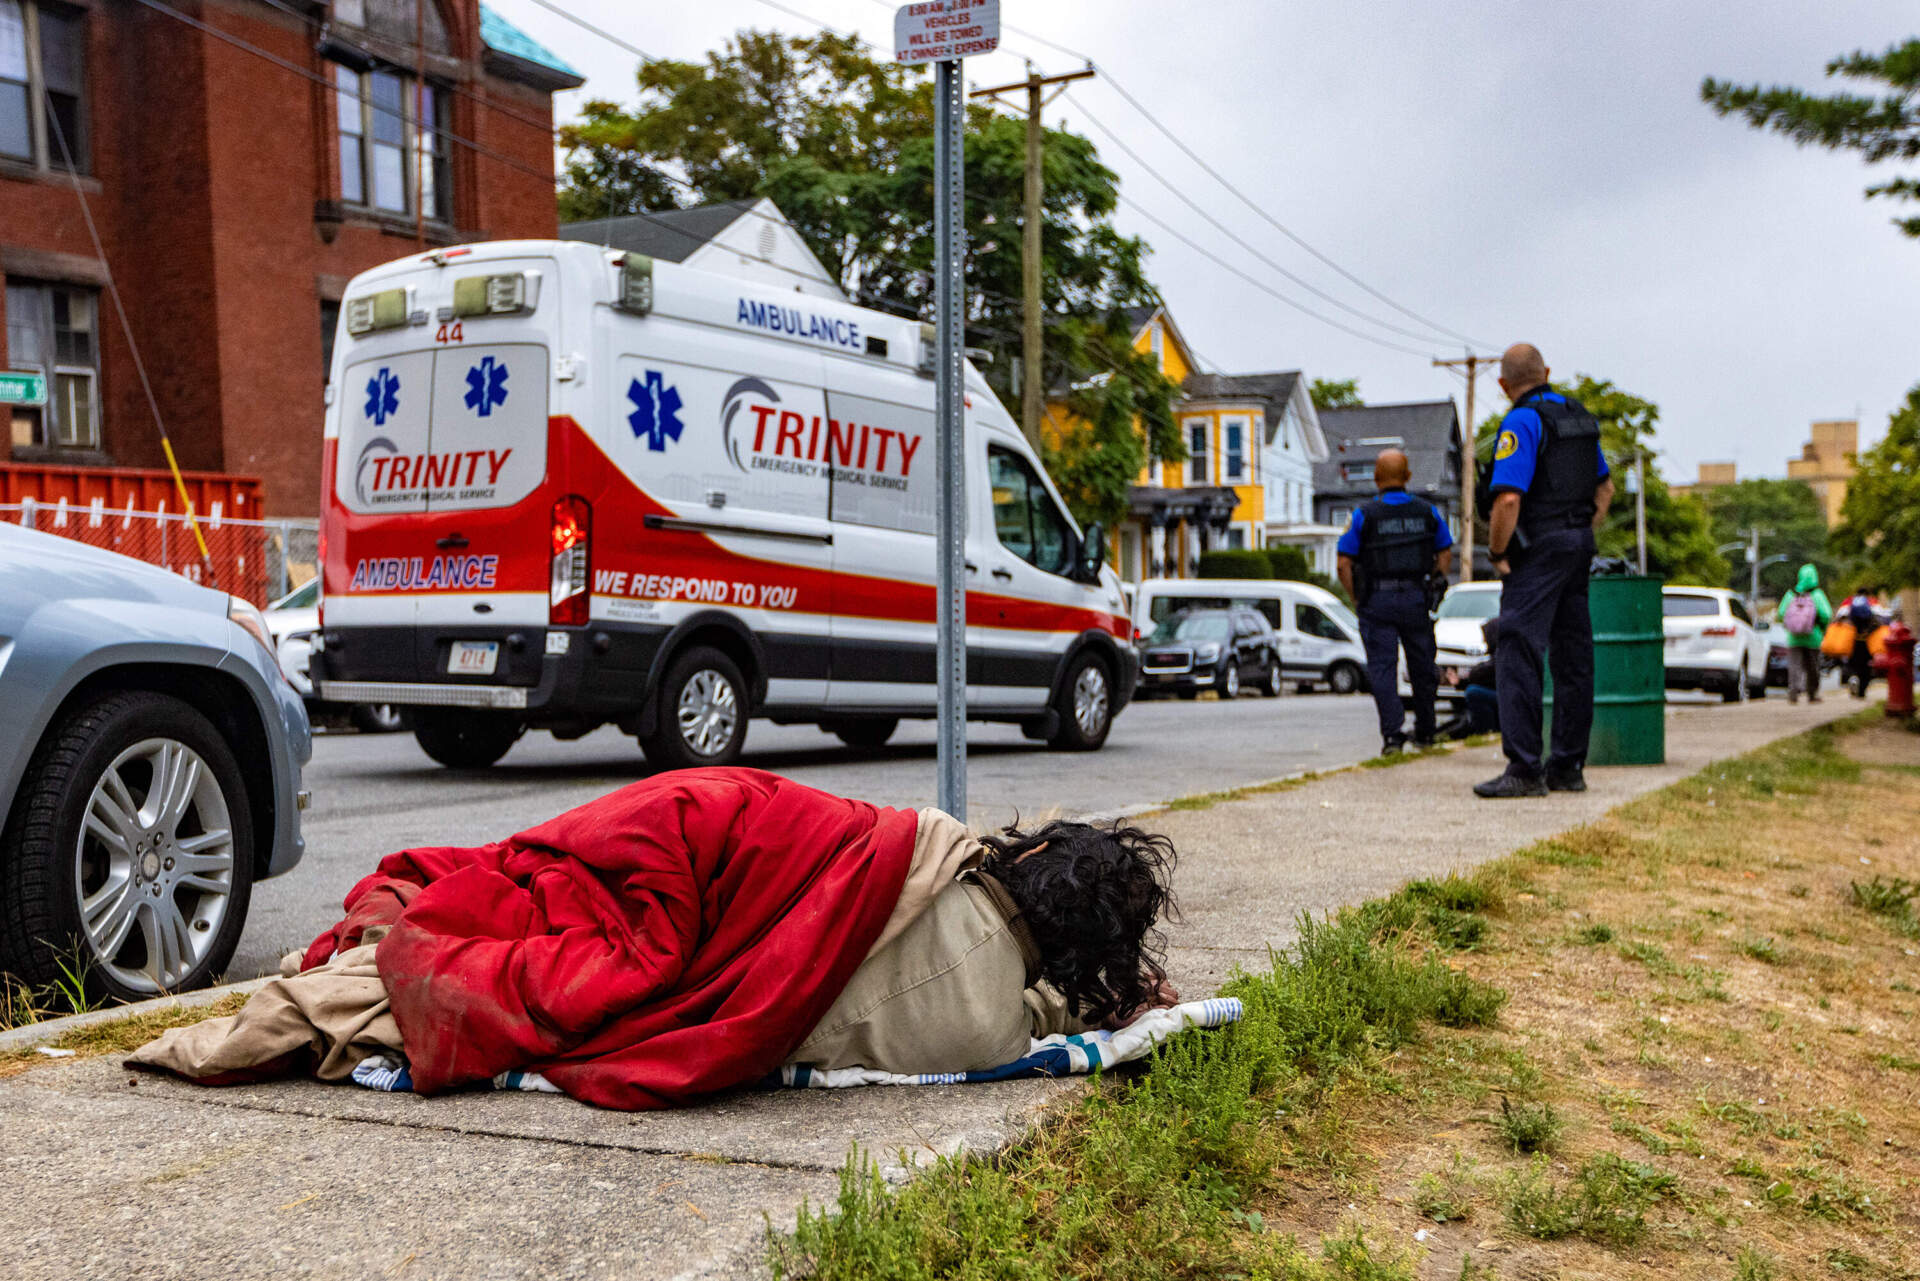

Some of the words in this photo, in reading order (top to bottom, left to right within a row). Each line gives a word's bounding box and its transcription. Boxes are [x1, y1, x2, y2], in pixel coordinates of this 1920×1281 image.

[923, 12, 971, 28] VEHICLES
[929, 2, 944, 13] AM
[896, 50, 908, 61] AT
[954, 37, 998, 55] EXPENSE
[909, 32, 931, 45] WILL
[934, 30, 948, 43] BE
[949, 25, 983, 40] TOWED
[435, 322, 464, 344] 44
[737, 298, 861, 348] AMBULANCE
[750, 404, 922, 477] TRINITY
[371, 448, 513, 492] TRINITY
[750, 455, 818, 478] EMERGENCY
[821, 467, 867, 487] MEDICAL
[869, 474, 909, 492] SERVICE
[371, 493, 418, 505] EMERGENCY
[420, 489, 456, 501] MEDICAL
[459, 487, 496, 500] SERVICE
[351, 555, 499, 591] AMBULANCE
[595, 569, 628, 594] WE
[629, 572, 728, 602] RESPOND
[732, 581, 755, 604] TO
[758, 584, 798, 608] YOU
